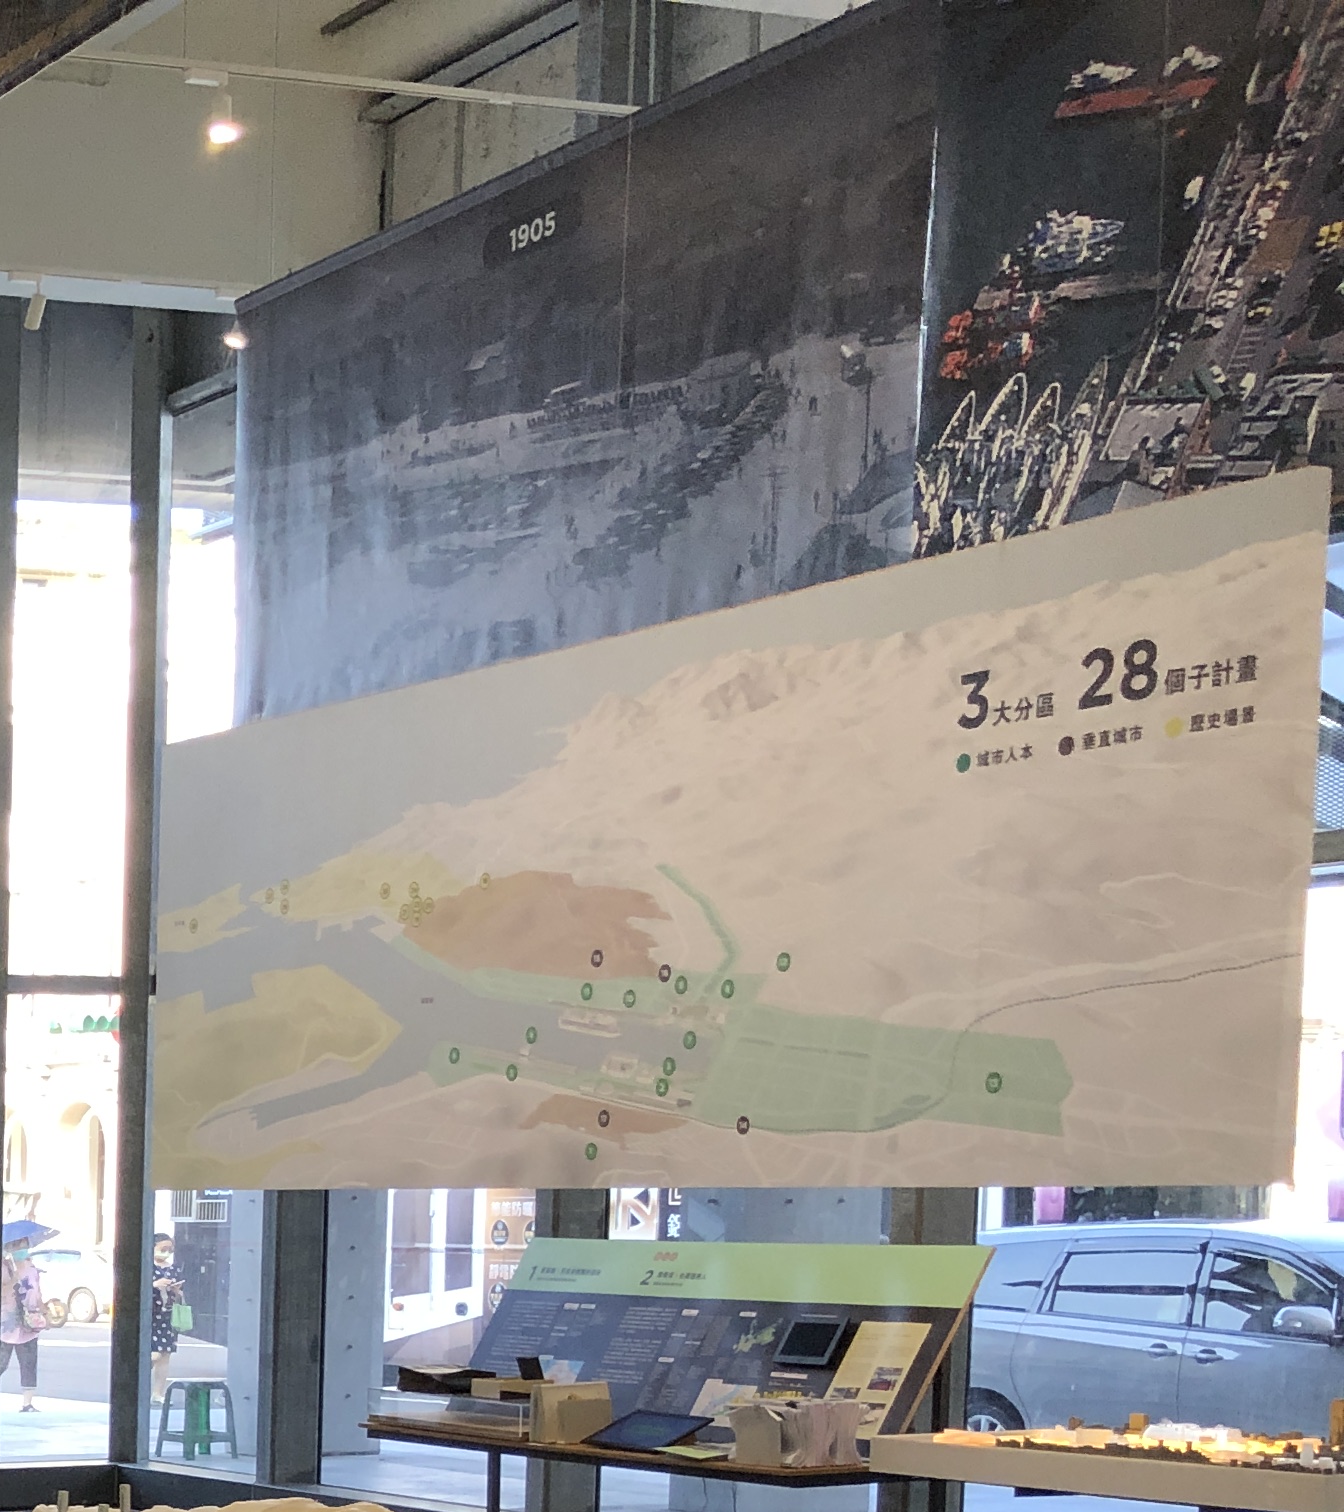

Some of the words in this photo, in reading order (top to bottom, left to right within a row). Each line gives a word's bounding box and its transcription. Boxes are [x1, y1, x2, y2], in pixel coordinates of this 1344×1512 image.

[509, 211, 556, 252] 1905
[957, 669, 1055, 730] 3大分區
[1077, 637, 1260, 710] 28個子計畫
[1081, 724, 1144, 752] 垂直城市
[976, 743, 1033, 768] 城市人本
[639, 1269, 654, 1286] 2
